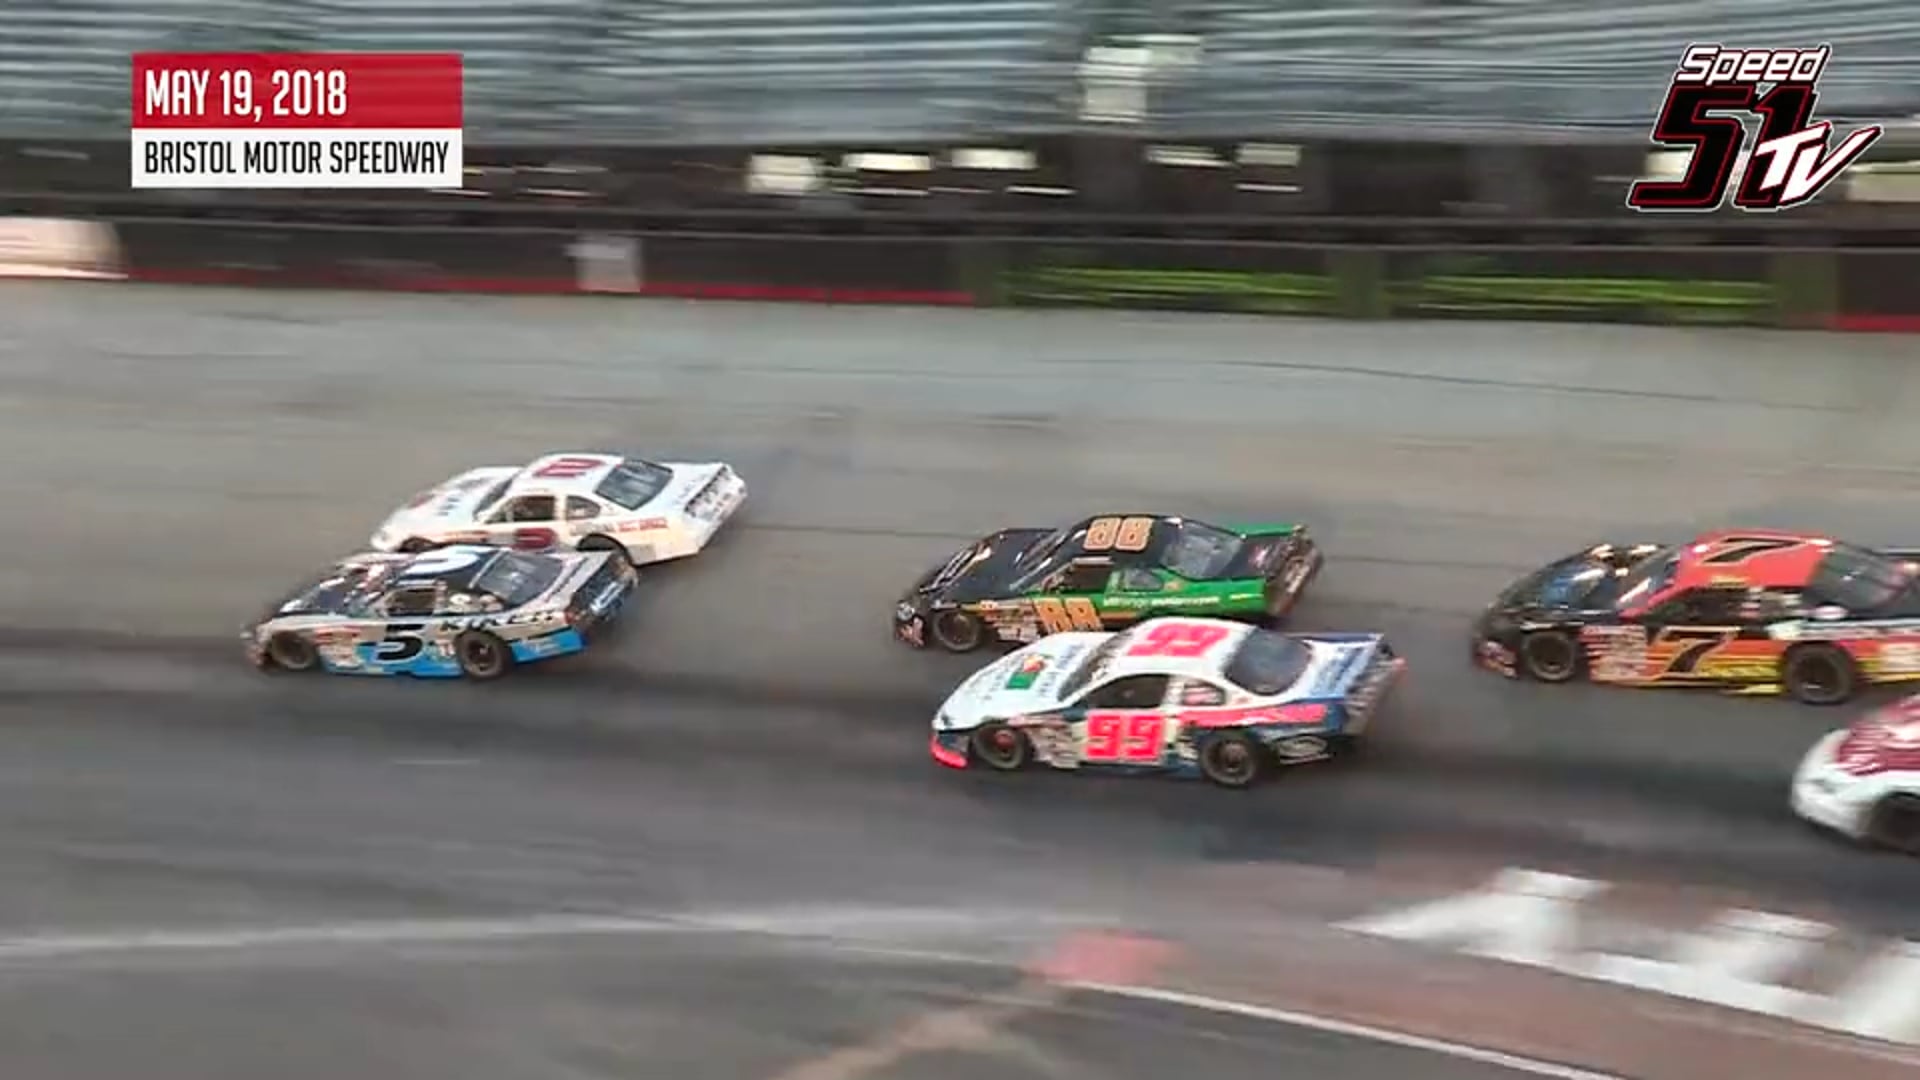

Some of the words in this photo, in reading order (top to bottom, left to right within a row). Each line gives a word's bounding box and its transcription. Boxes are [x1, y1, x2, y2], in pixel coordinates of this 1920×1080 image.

[1083, 516, 1155, 551] 88
[1702, 535, 1801, 564] 7
[374, 622, 426, 662] 5
[1126, 622, 1231, 657] 99
[1650, 626, 1743, 677] 7
[1085, 711, 1166, 762] 99
